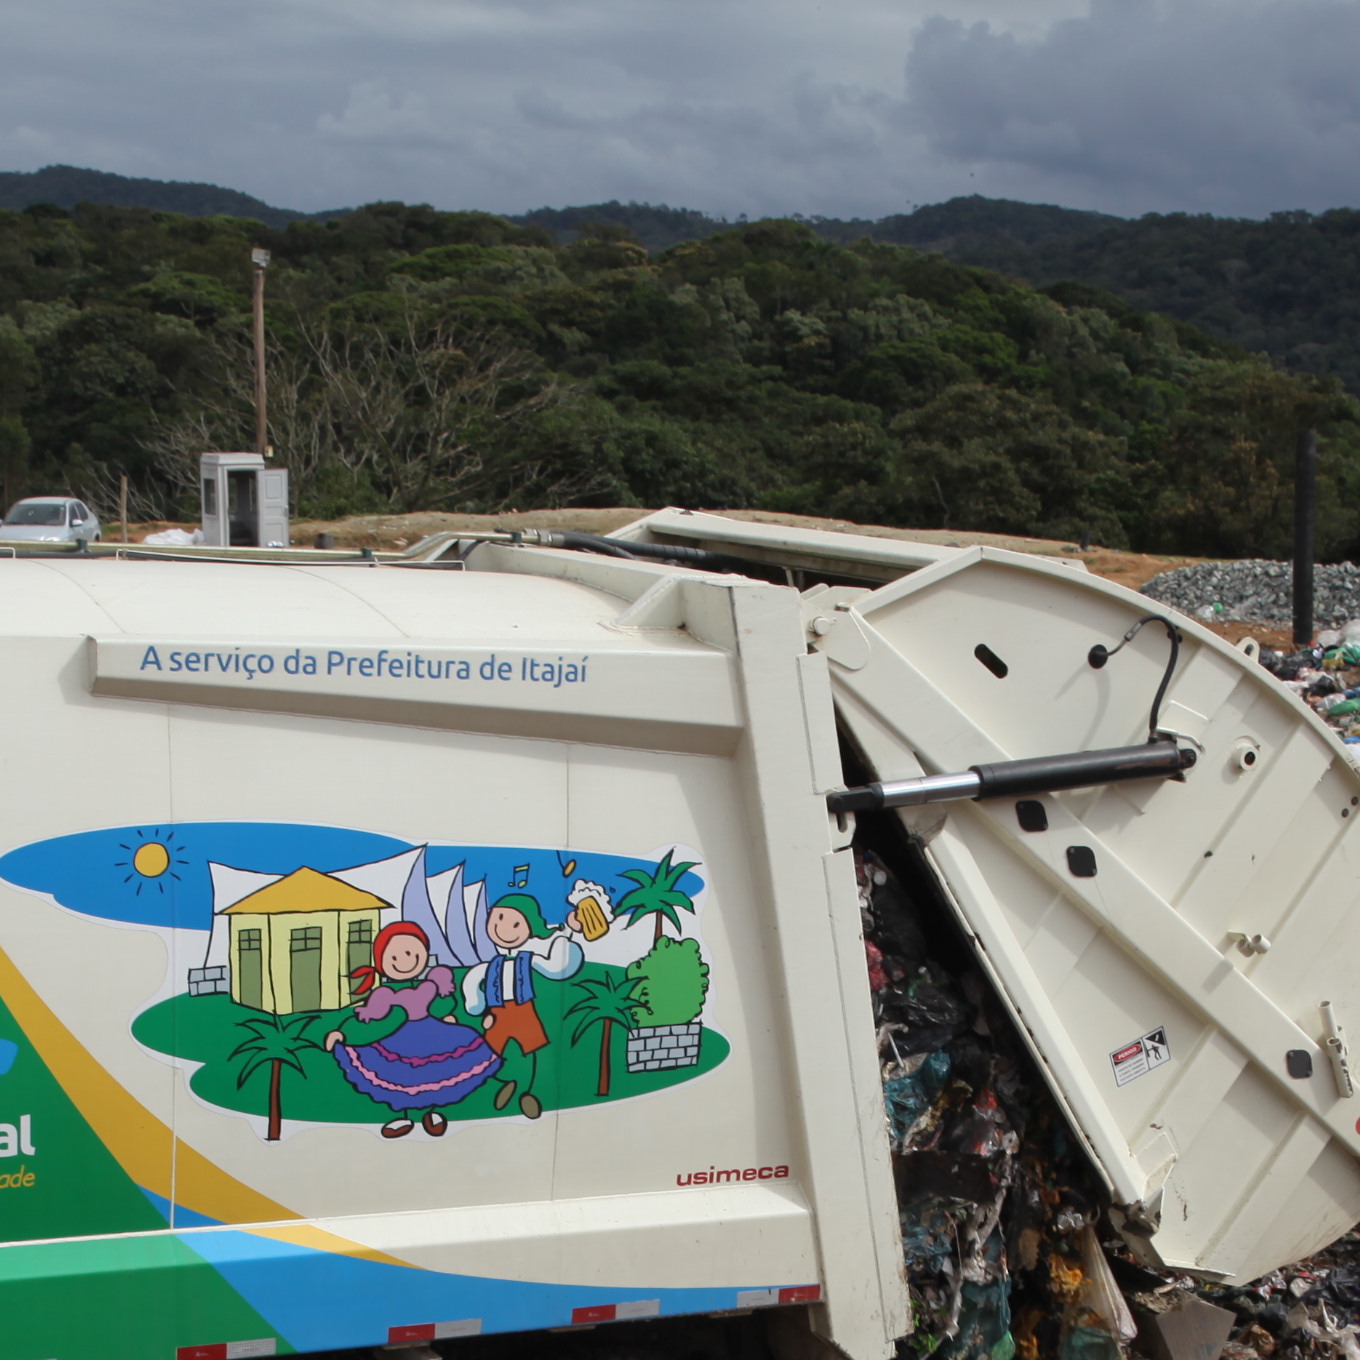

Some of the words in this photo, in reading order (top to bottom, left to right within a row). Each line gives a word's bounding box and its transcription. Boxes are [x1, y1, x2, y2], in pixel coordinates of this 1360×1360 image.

[140, 646, 162, 671] A
[169, 650, 275, 681] serviço
[283, 647, 318, 676] da
[328, 650, 470, 681] Prefeitura
[479, 653, 513, 682] de
[521, 655, 589, 689] Itajaí
[676, 1164, 790, 1187] usimeca
